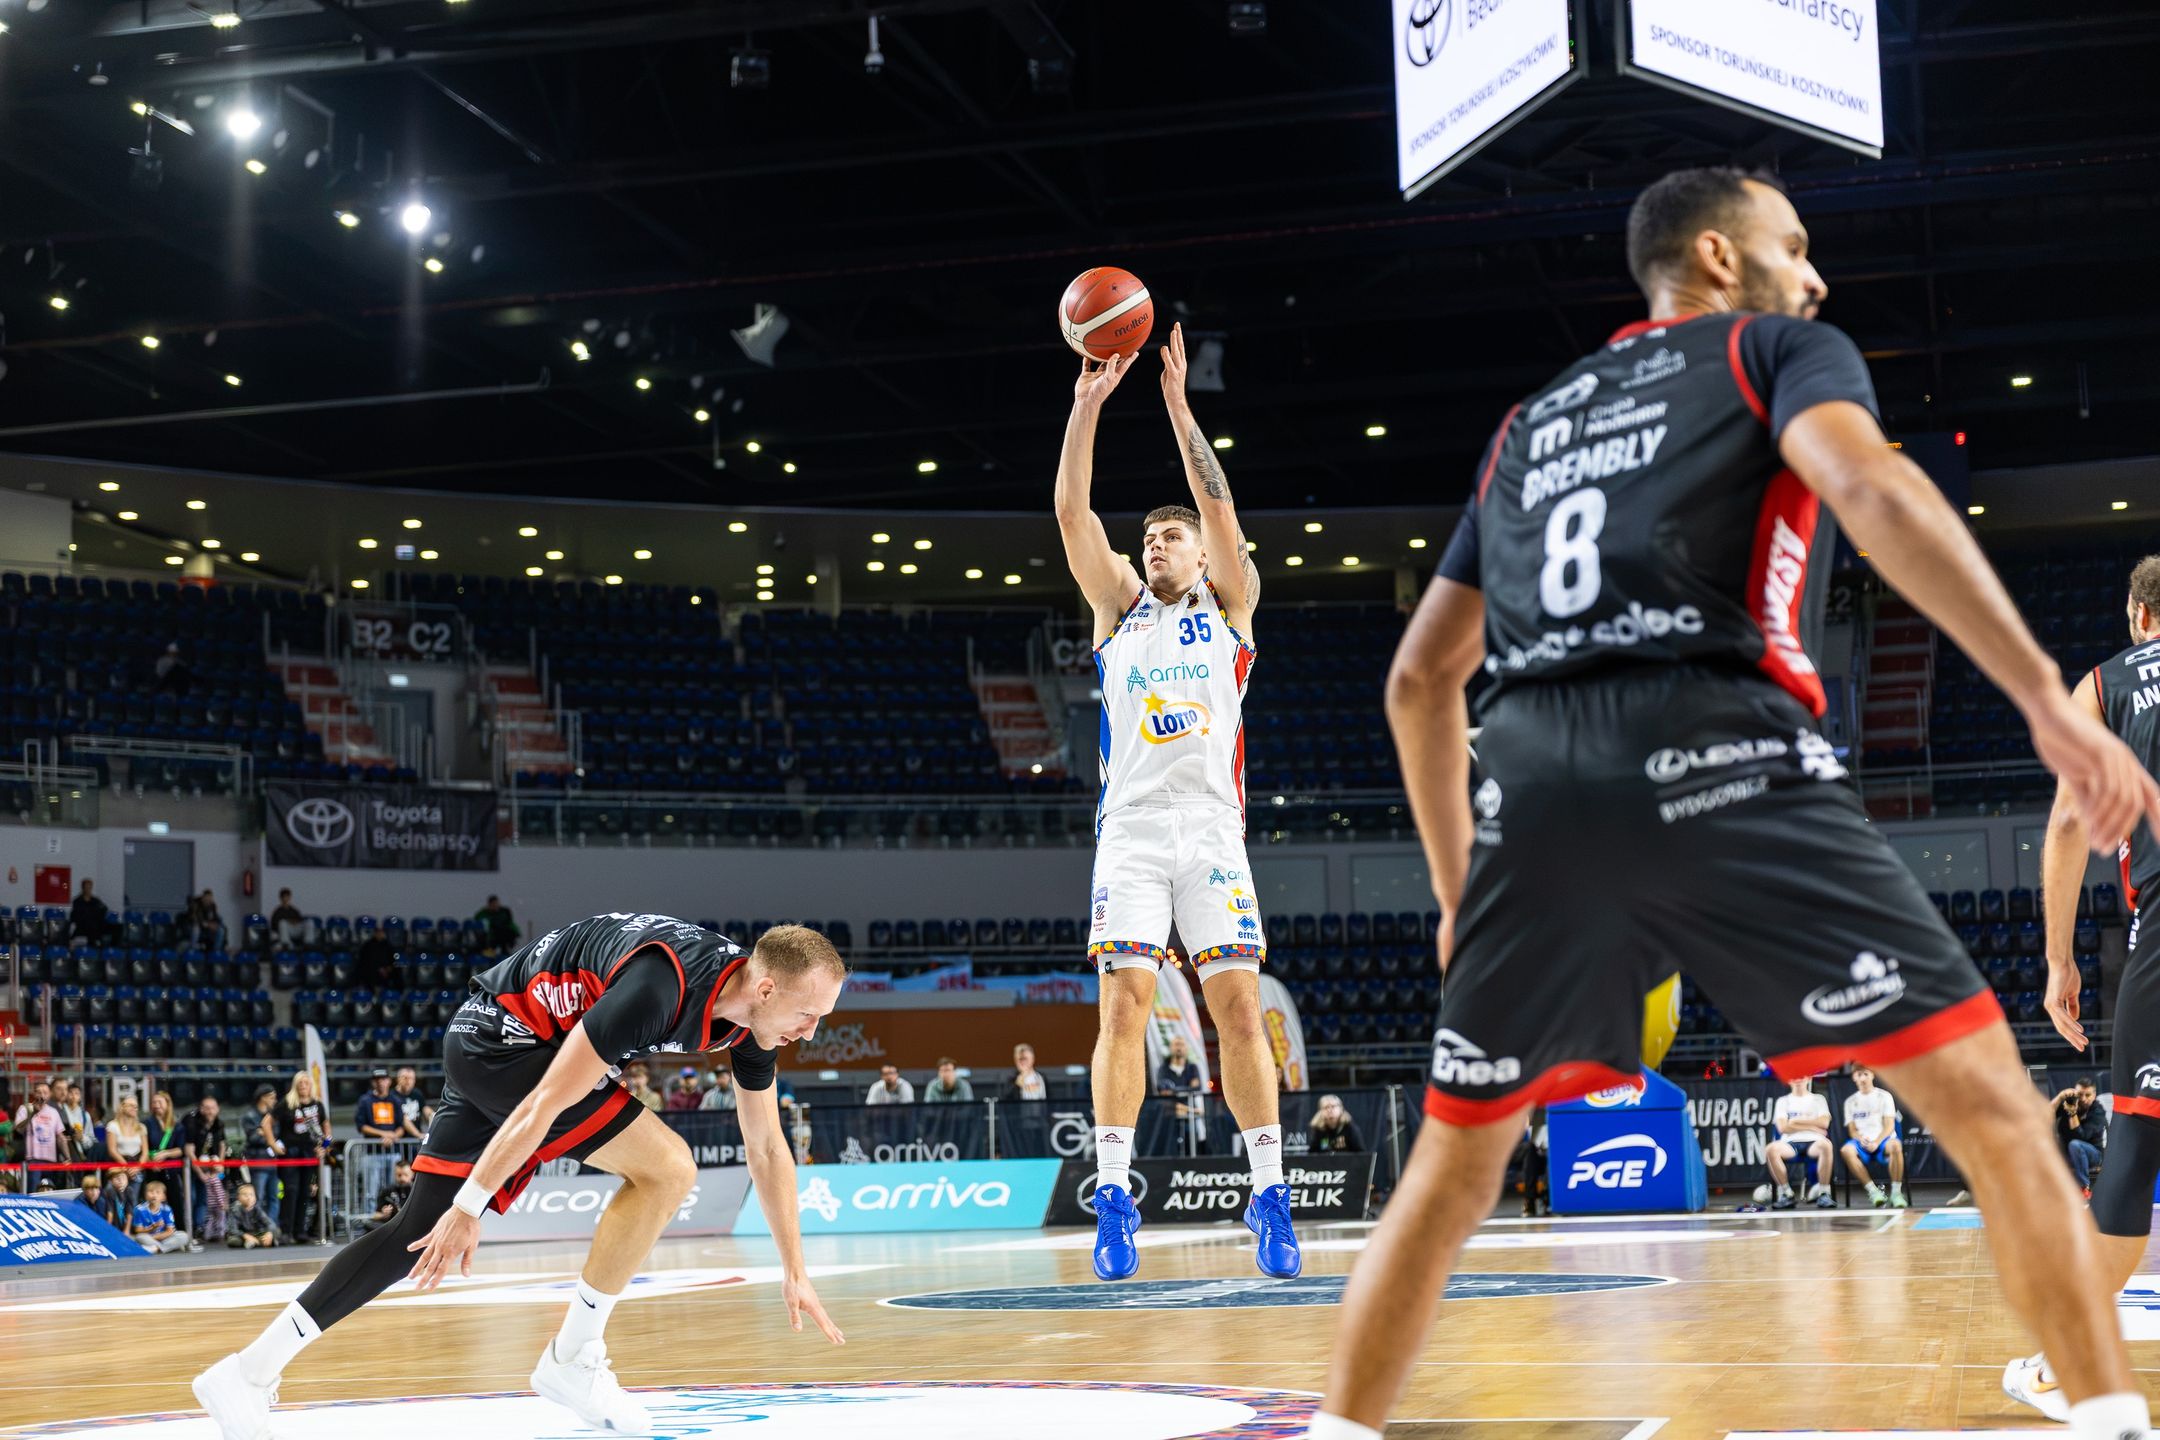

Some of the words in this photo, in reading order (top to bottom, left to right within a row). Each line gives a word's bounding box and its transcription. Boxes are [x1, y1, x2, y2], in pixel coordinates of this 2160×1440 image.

[1651, 24, 1711, 59] SPONSOR
[1714, 47, 1788, 87] TORUŃSKIEJ
[1792, 76, 1870, 115] KOSZYKÓWKI
[1114, 312, 1149, 337] molten
[1520, 424, 1668, 512] BREMBLY
[1539, 486, 1608, 620] 8
[408, 622, 451, 653] C2
[1178, 612, 1212, 646] 35
[1149, 661, 1210, 684] arriva
[1152, 709, 1198, 736] LOTTO
[372, 801, 443, 827] Toyota
[372, 828, 481, 855] Bednarscy
[873, 1137, 960, 1163] arriva
[1254, 1139, 1279, 1147] PEAK
[1169, 1167, 1348, 1188] Merced-Benz
[1567, 1159, 1648, 1189] PGE
[852, 1175, 1012, 1211] arriva
[1163, 1189, 1241, 1211] AUTO
